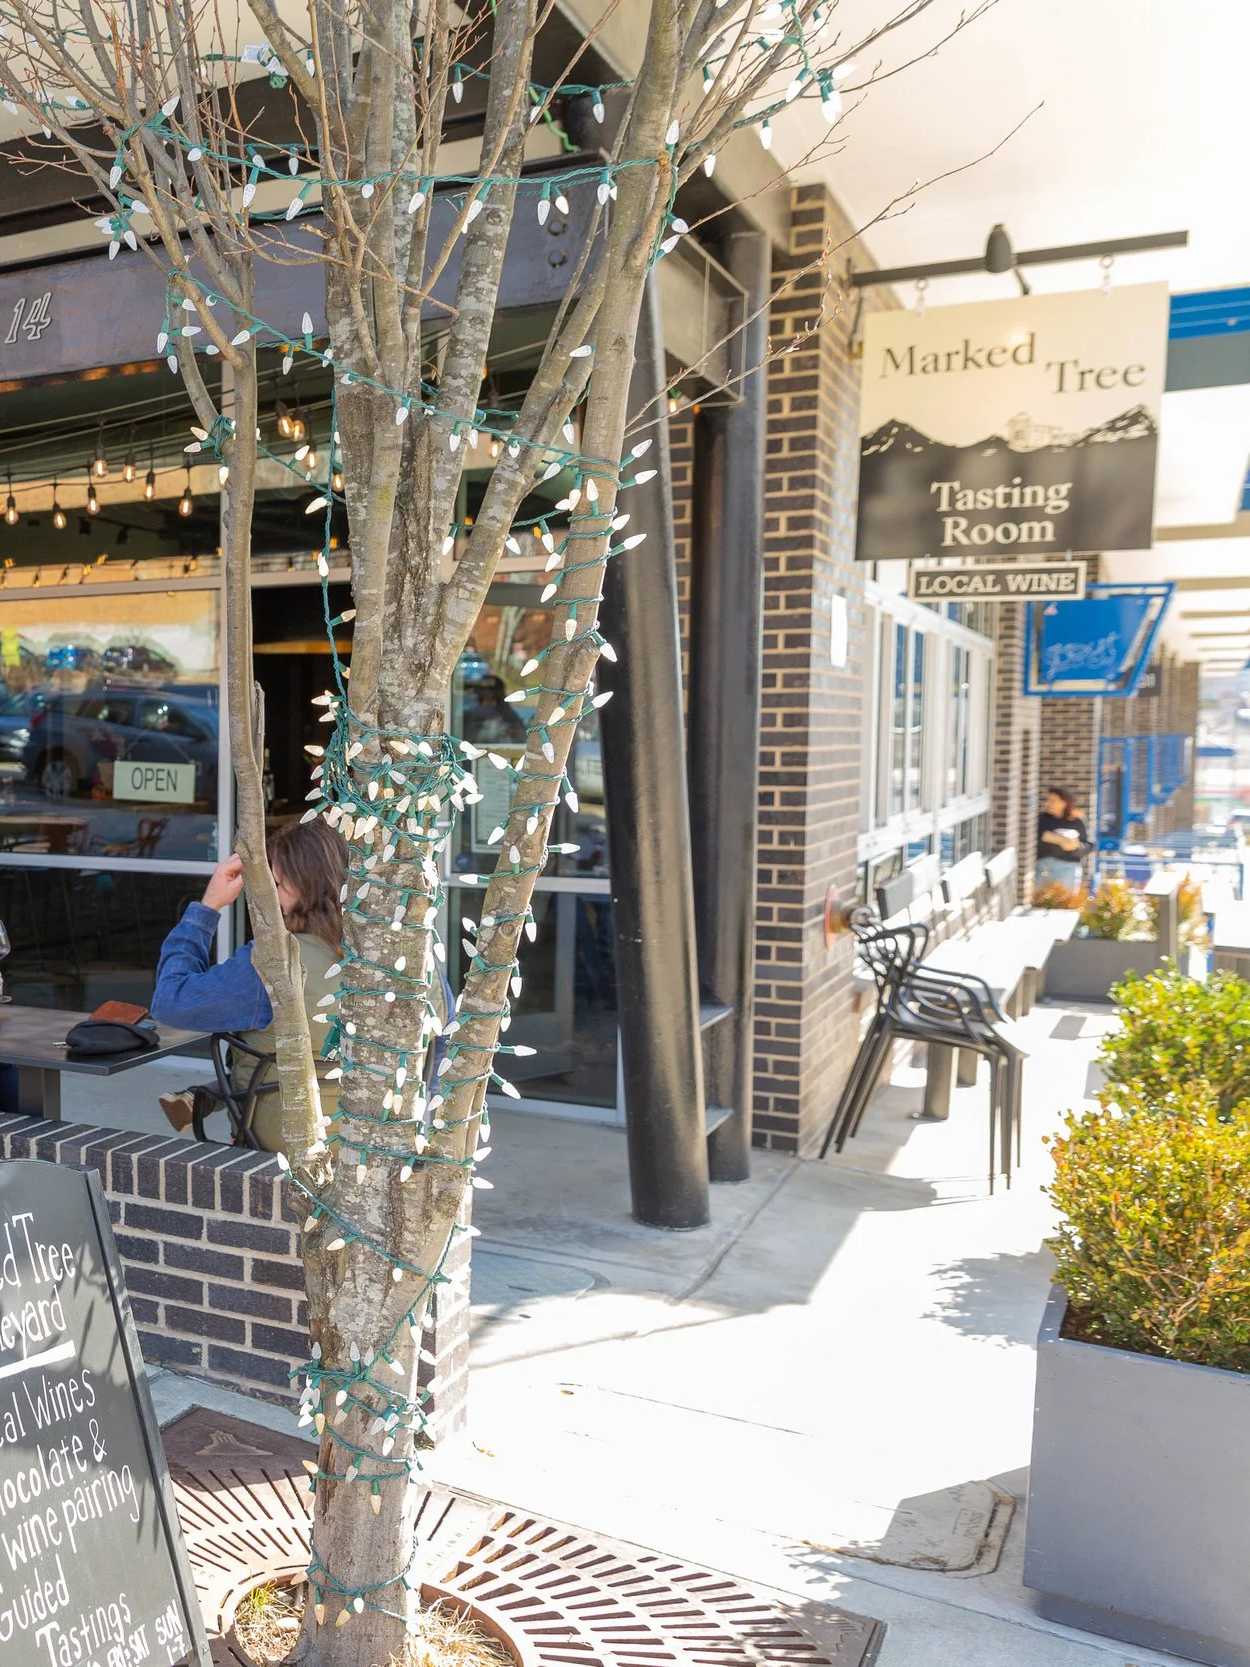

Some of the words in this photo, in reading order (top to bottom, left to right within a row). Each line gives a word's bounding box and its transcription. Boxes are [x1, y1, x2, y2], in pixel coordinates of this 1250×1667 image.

[5, 291, 51, 343] 14
[880, 331, 1036, 378] Marked
[1046, 359, 1146, 393] Tree
[930, 476, 1073, 514] Tasting
[940, 515, 1055, 546] Room
[918, 575, 1001, 594] LOCAL
[1006, 573, 1075, 592] WINE
[131, 767, 178, 791] OPEN
[12, 1212, 76, 1284] Tree
[23, 1368, 96, 1430] Wines
[88, 1418, 108, 1463] &
[1, 1502, 63, 1571] wine
[62, 1464, 141, 1553] pairing
[35, 1592, 132, 1667] Tastings
[155, 1599, 184, 1645] SUN
